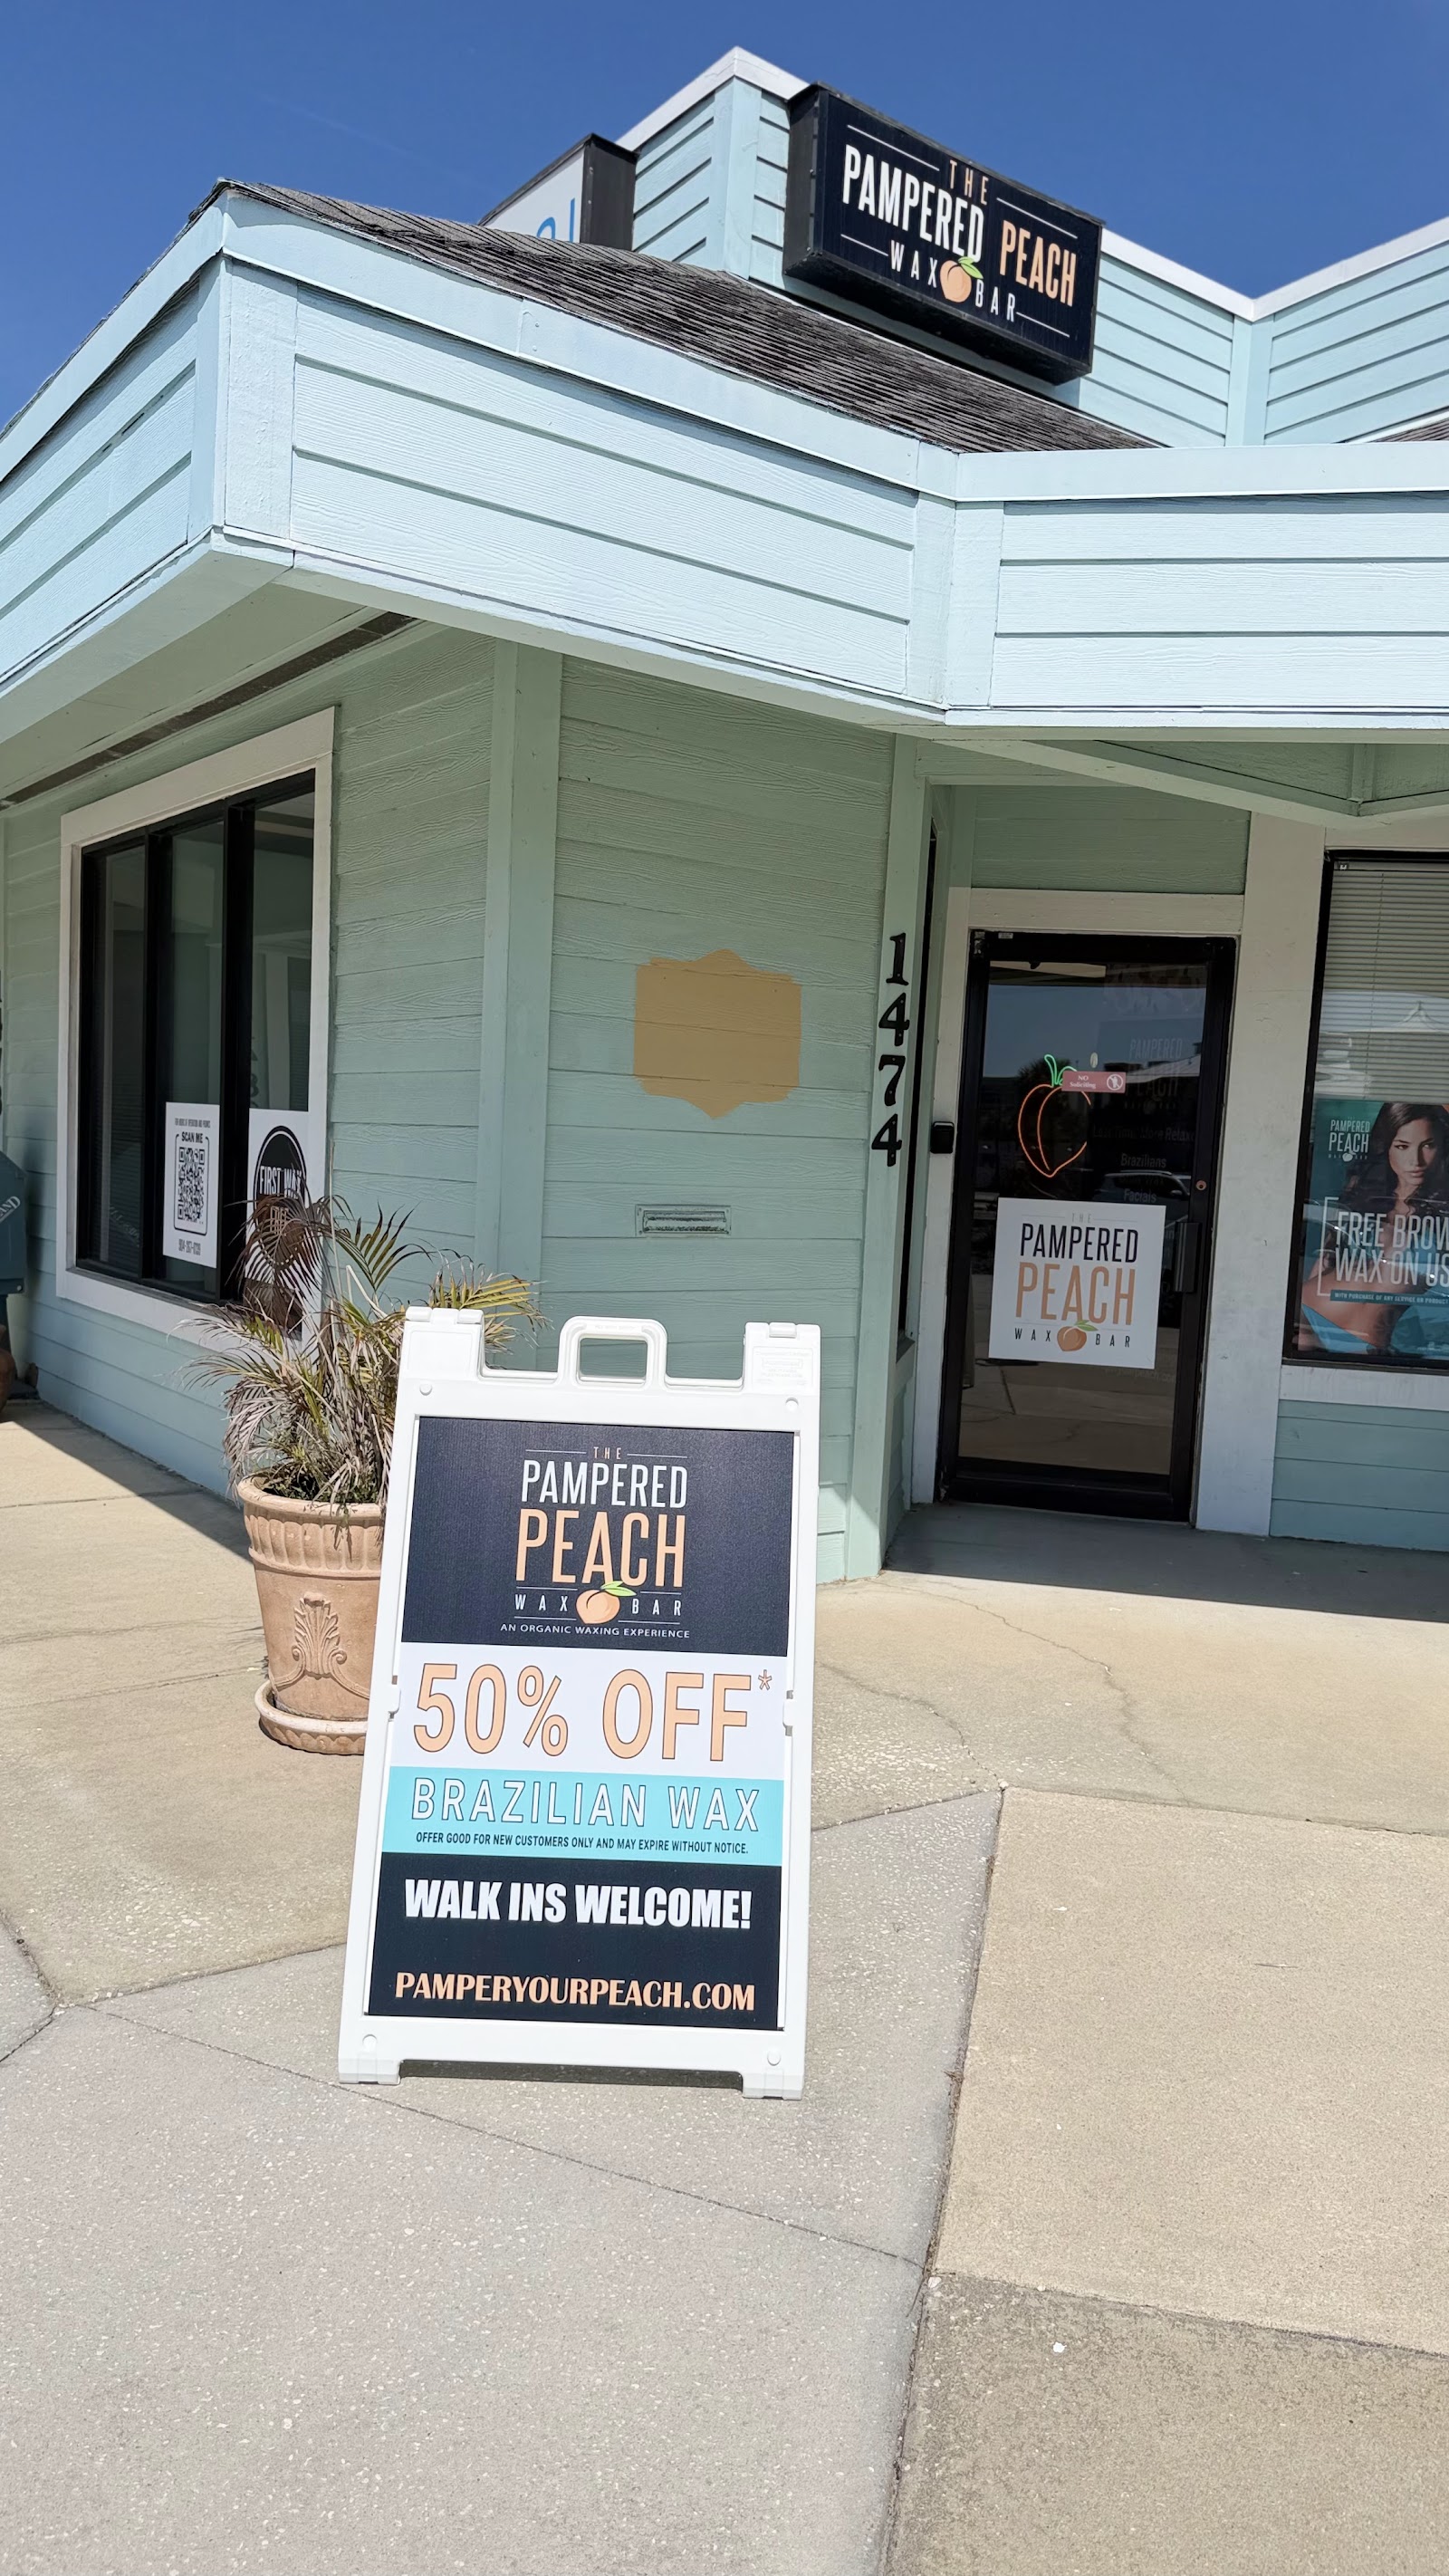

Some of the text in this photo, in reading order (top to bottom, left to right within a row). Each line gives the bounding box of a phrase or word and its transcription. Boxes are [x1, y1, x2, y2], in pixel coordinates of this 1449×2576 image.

[949, 159, 989, 206] THE
[842, 143, 1077, 307] PAMPERED PEACH
[890, 239, 1016, 322] WAX BAR
[871, 932, 910, 1167] 1474
[181, 1131, 204, 1144] SCAN ME
[1329, 1119, 1370, 1133] PAMPERED
[1329, 1132, 1369, 1153] PEACH
[1120, 1152, 1167, 1168] Brazilians
[259, 1165, 282, 1197] FIRST
[1123, 1187, 1157, 1204] Facials
[1071, 1213, 1093, 1224] THE
[1336, 1211, 1449, 1251] FREE BROW
[1020, 1223, 1138, 1263] PAMPERED
[1335, 1247, 1449, 1288] WAX ON US
[1015, 1262, 1136, 1325] PEACH
[1014, 1327, 1130, 1348] WAX BAR
[593, 1446, 622, 1459] THE
[521, 1459, 688, 1508] PAMPERED
[515, 1508, 686, 1587] PEACH
[514, 1593, 682, 1616] WAX BAR
[500, 1623, 690, 1639] AN ORGANIC WAXING EXPERIENCE
[413, 1662, 569, 1757] 50%
[411, 1776, 760, 1832] BRAZILIAN WAX
[416, 1831, 749, 1854] OFFER GOOD FOR NEW CUSTOMERS ONLY AND MAY EXPIRE WITHOUT NOTICE.
[405, 1879, 753, 1929] WALK INS WELCOME!
[395, 1971, 755, 2012] PAMPERYOURPEACH.COM
